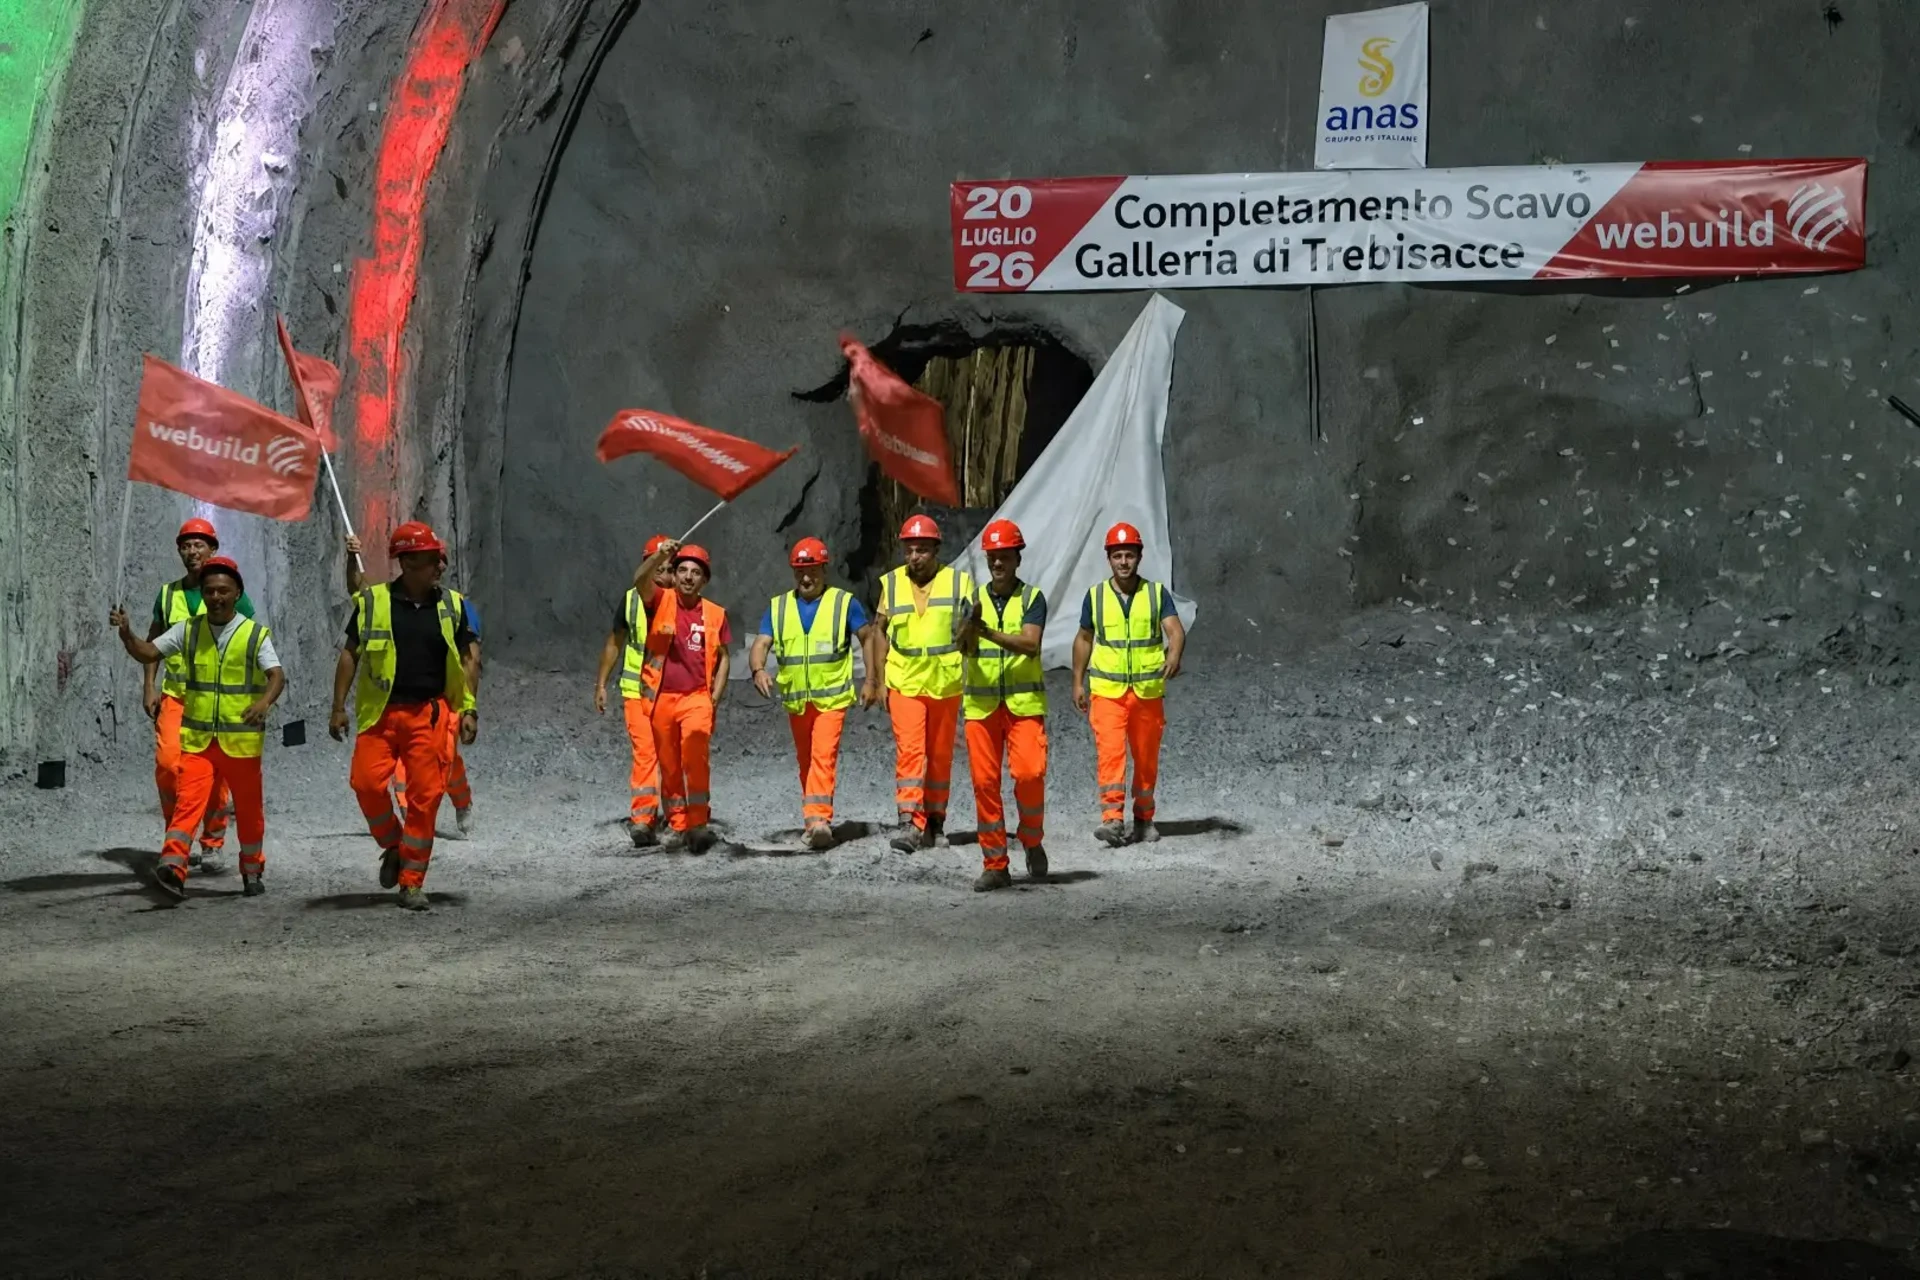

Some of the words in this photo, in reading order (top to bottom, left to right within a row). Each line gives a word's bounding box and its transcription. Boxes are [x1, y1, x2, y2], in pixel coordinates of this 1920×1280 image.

[1325, 103, 1419, 131] anas
[1325, 135, 1361, 143] GRUPPO
[1377, 134, 1418, 143] ITALIANE
[962, 186, 1032, 220] 20
[1114, 190, 1453, 237] Completamento
[1465, 184, 1592, 219] Scavo
[960, 227, 1037, 246] LUGLIO
[1594, 209, 1774, 250] webuild
[966, 251, 1034, 287] 26
[1075, 242, 1238, 278] Galleria
[1253, 237, 1290, 273] di
[1301, 232, 1525, 273] Trebisacce
[148, 421, 260, 465] webuild
